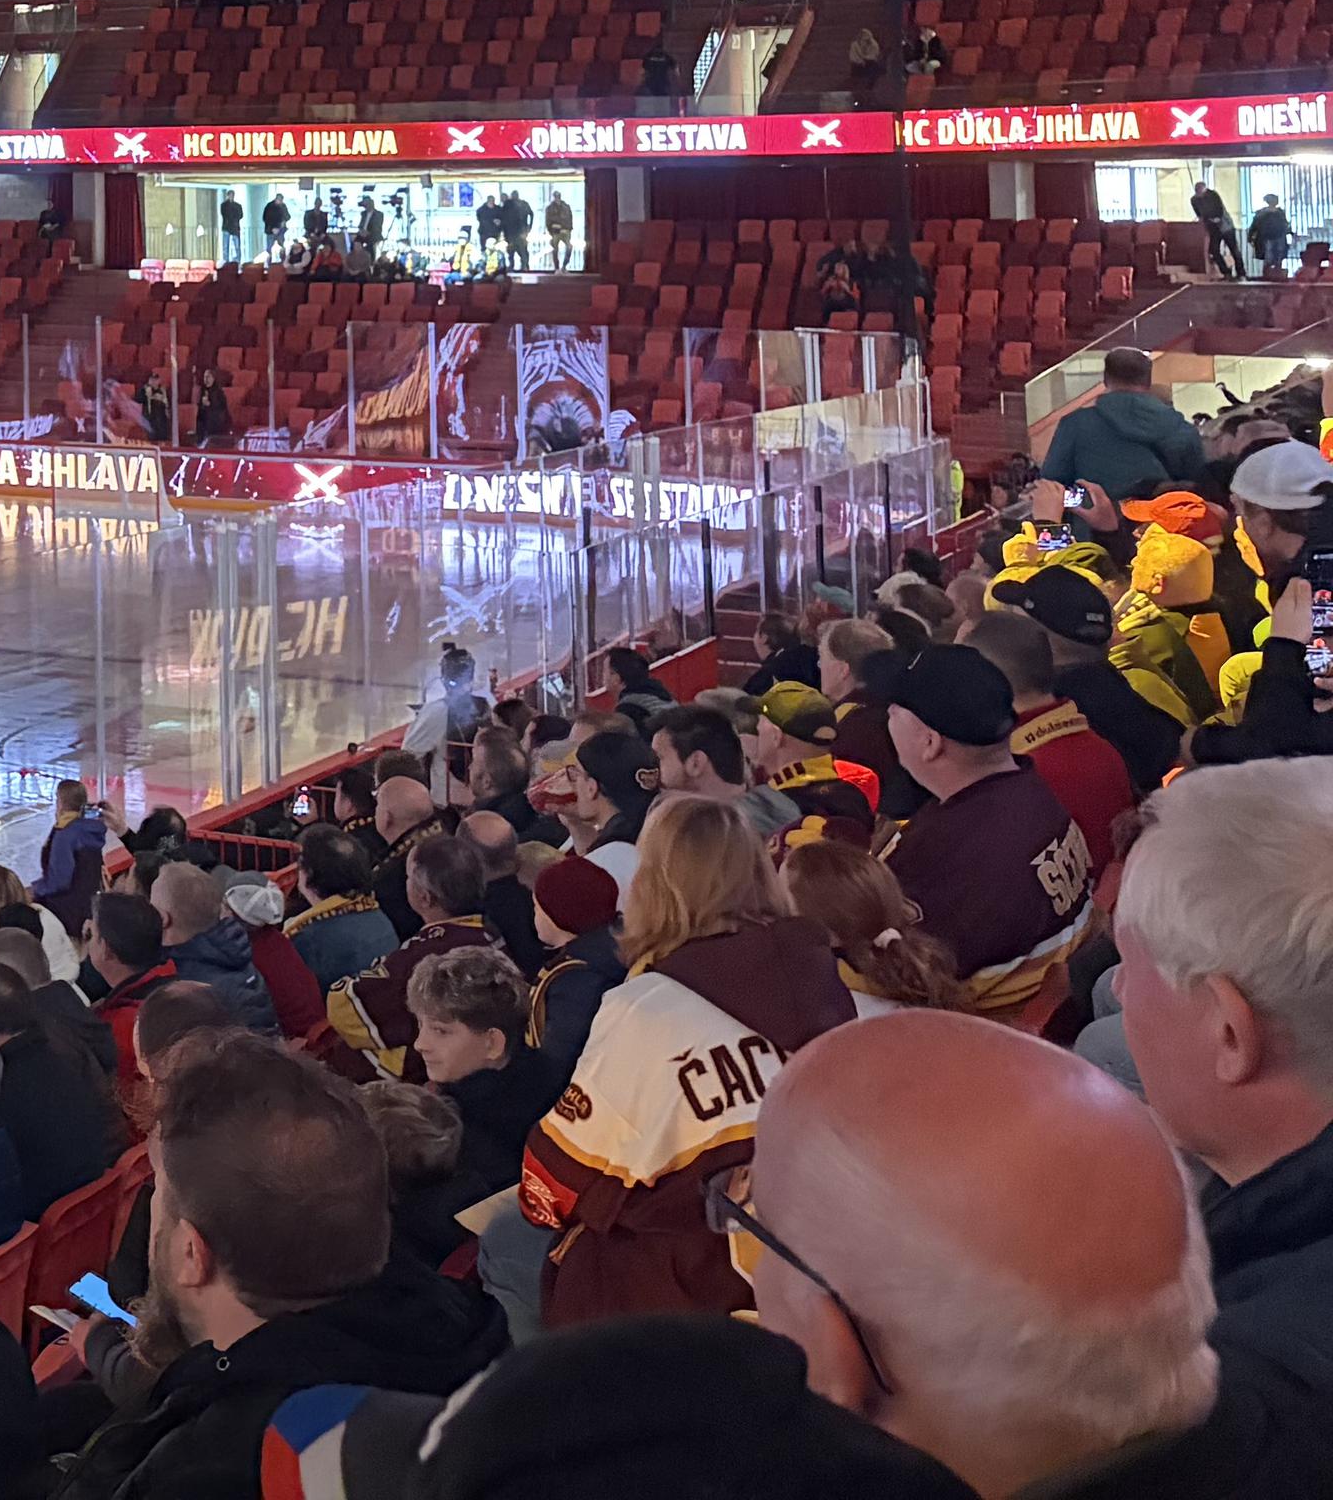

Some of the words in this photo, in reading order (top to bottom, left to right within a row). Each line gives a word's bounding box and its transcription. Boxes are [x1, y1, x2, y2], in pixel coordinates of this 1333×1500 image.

[896, 119, 930, 145] HC
[938, 113, 1027, 144] DUKLA
[1031, 112, 1140, 142] JIHLAVA
[1238, 94, 1327, 136] DNEŠNÍ
[184, 134, 214, 157] HC
[220, 132, 296, 157] DUKLA
[302, 131, 397, 156] JIHLAVA
[532, 120, 624, 153] DNEŠNÍ
[636, 124, 747, 151] SESTAVA
[25, 450, 158, 493] JIHLAVA
[669, 1035, 787, 1122] ČAC
